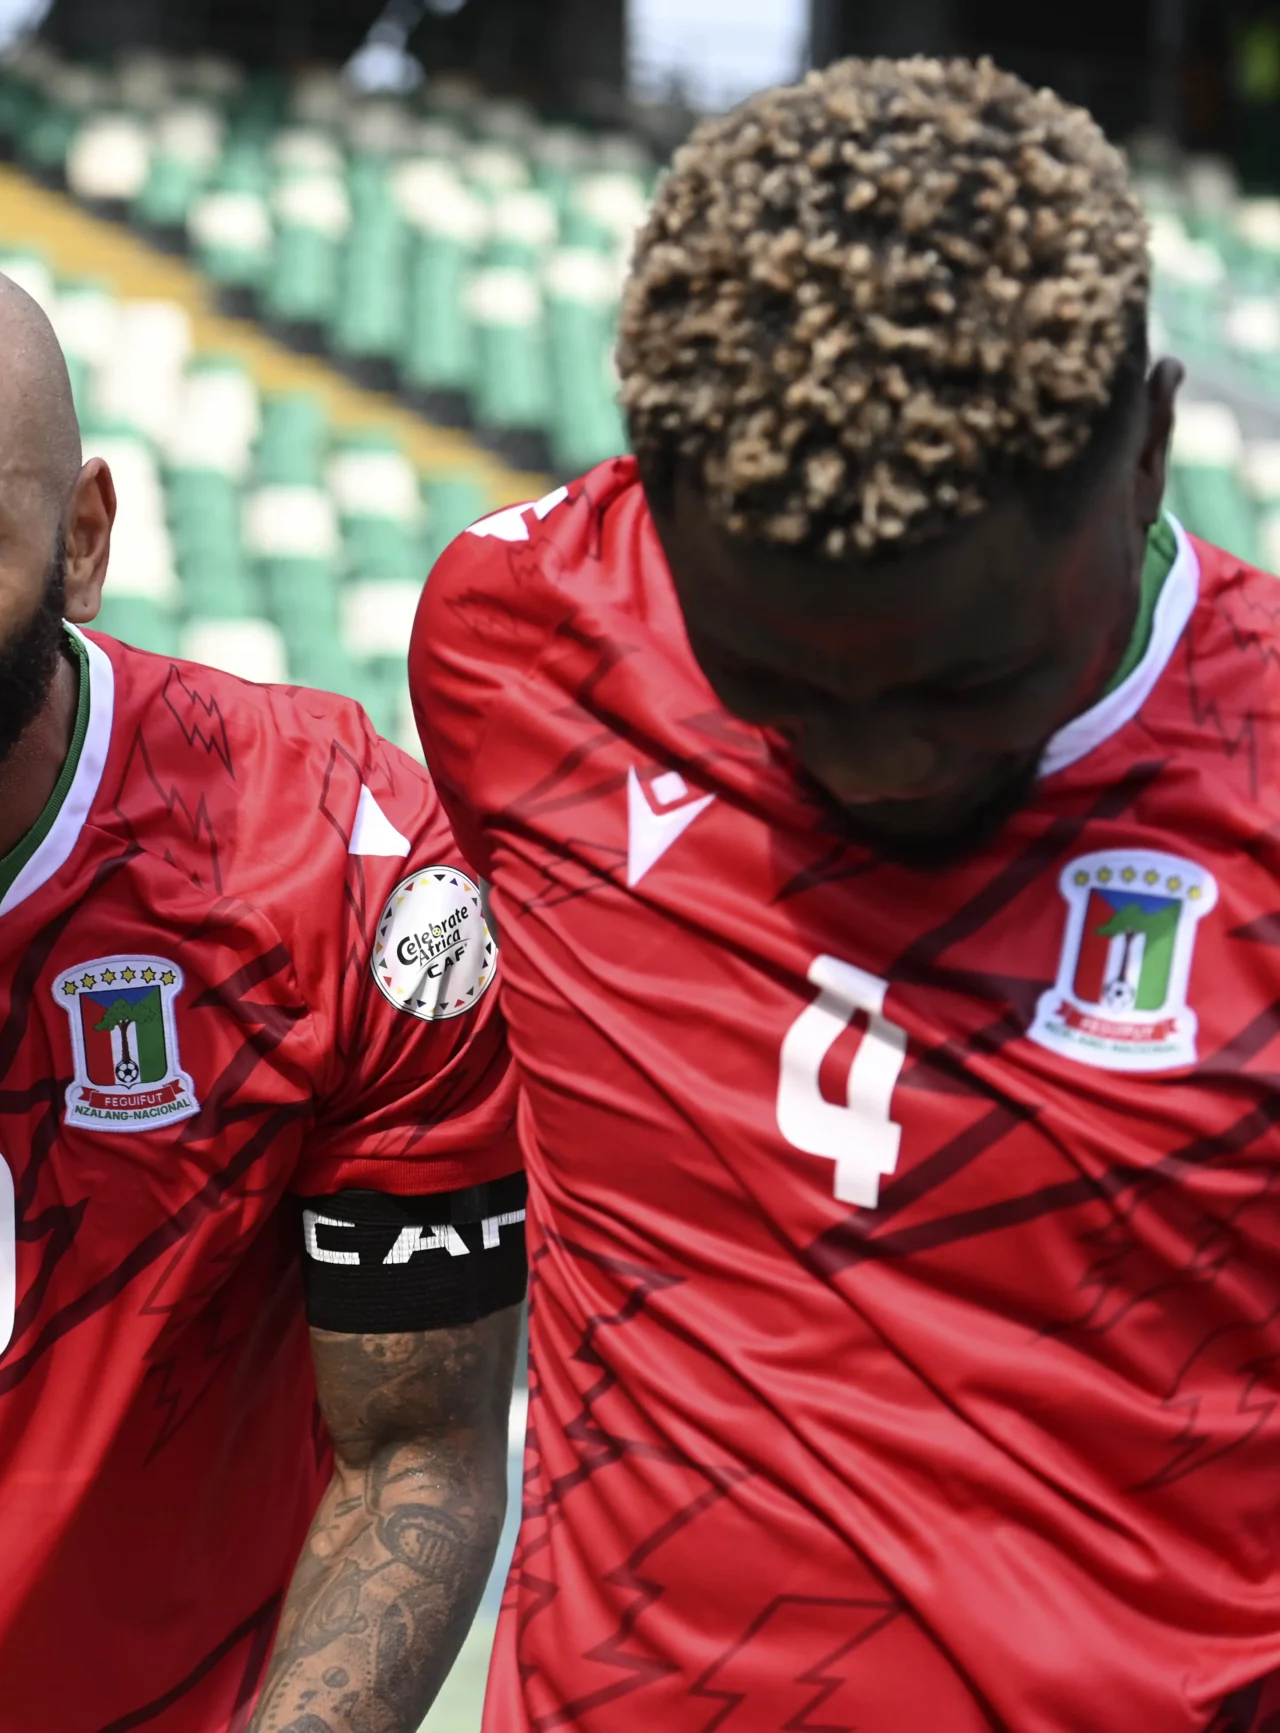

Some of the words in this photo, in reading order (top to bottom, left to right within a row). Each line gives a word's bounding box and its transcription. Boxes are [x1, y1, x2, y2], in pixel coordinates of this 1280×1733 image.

[396, 905, 470, 966] Celebrate
[418, 928, 462, 968] Africa
[426, 945, 466, 979] CAF
[104, 1092, 164, 1107] FEGUIFUT
[776, 953, 907, 1210] 4
[75, 1098, 191, 1121] NZALANG-NACIONAL
